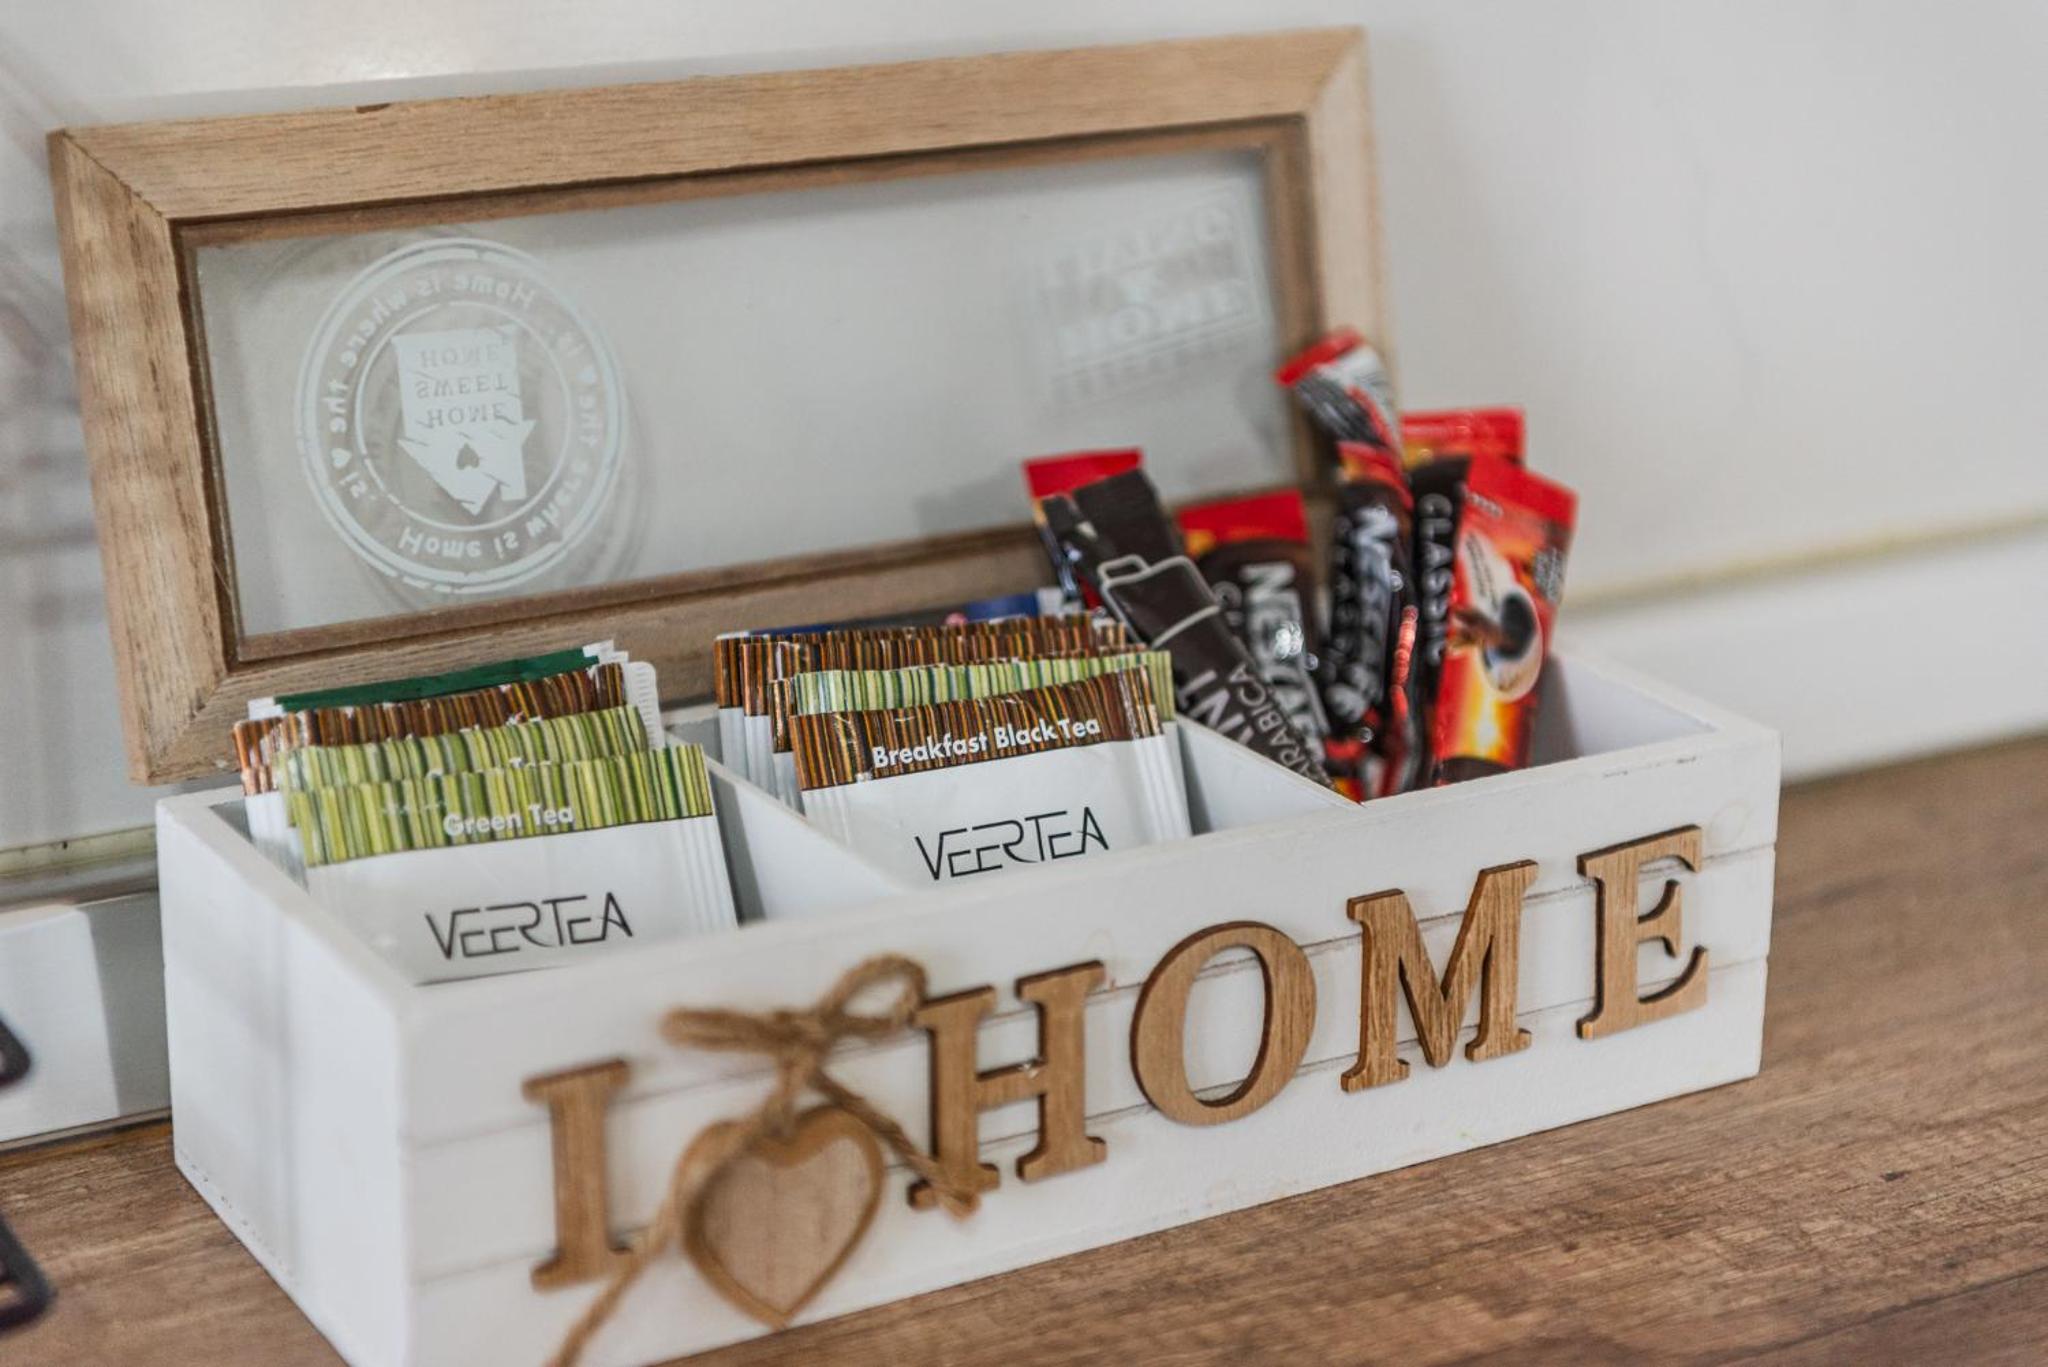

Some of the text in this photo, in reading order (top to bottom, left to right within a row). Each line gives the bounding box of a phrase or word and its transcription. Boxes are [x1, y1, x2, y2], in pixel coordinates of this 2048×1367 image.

[873, 717, 1101, 770] Breakfast Black Tea
[442, 802, 575, 837] Green Tea
[914, 806, 1109, 881] VEERTEA
[425, 892, 633, 961] VEERTEA
[522, 824, 1709, 1292] I HOME
